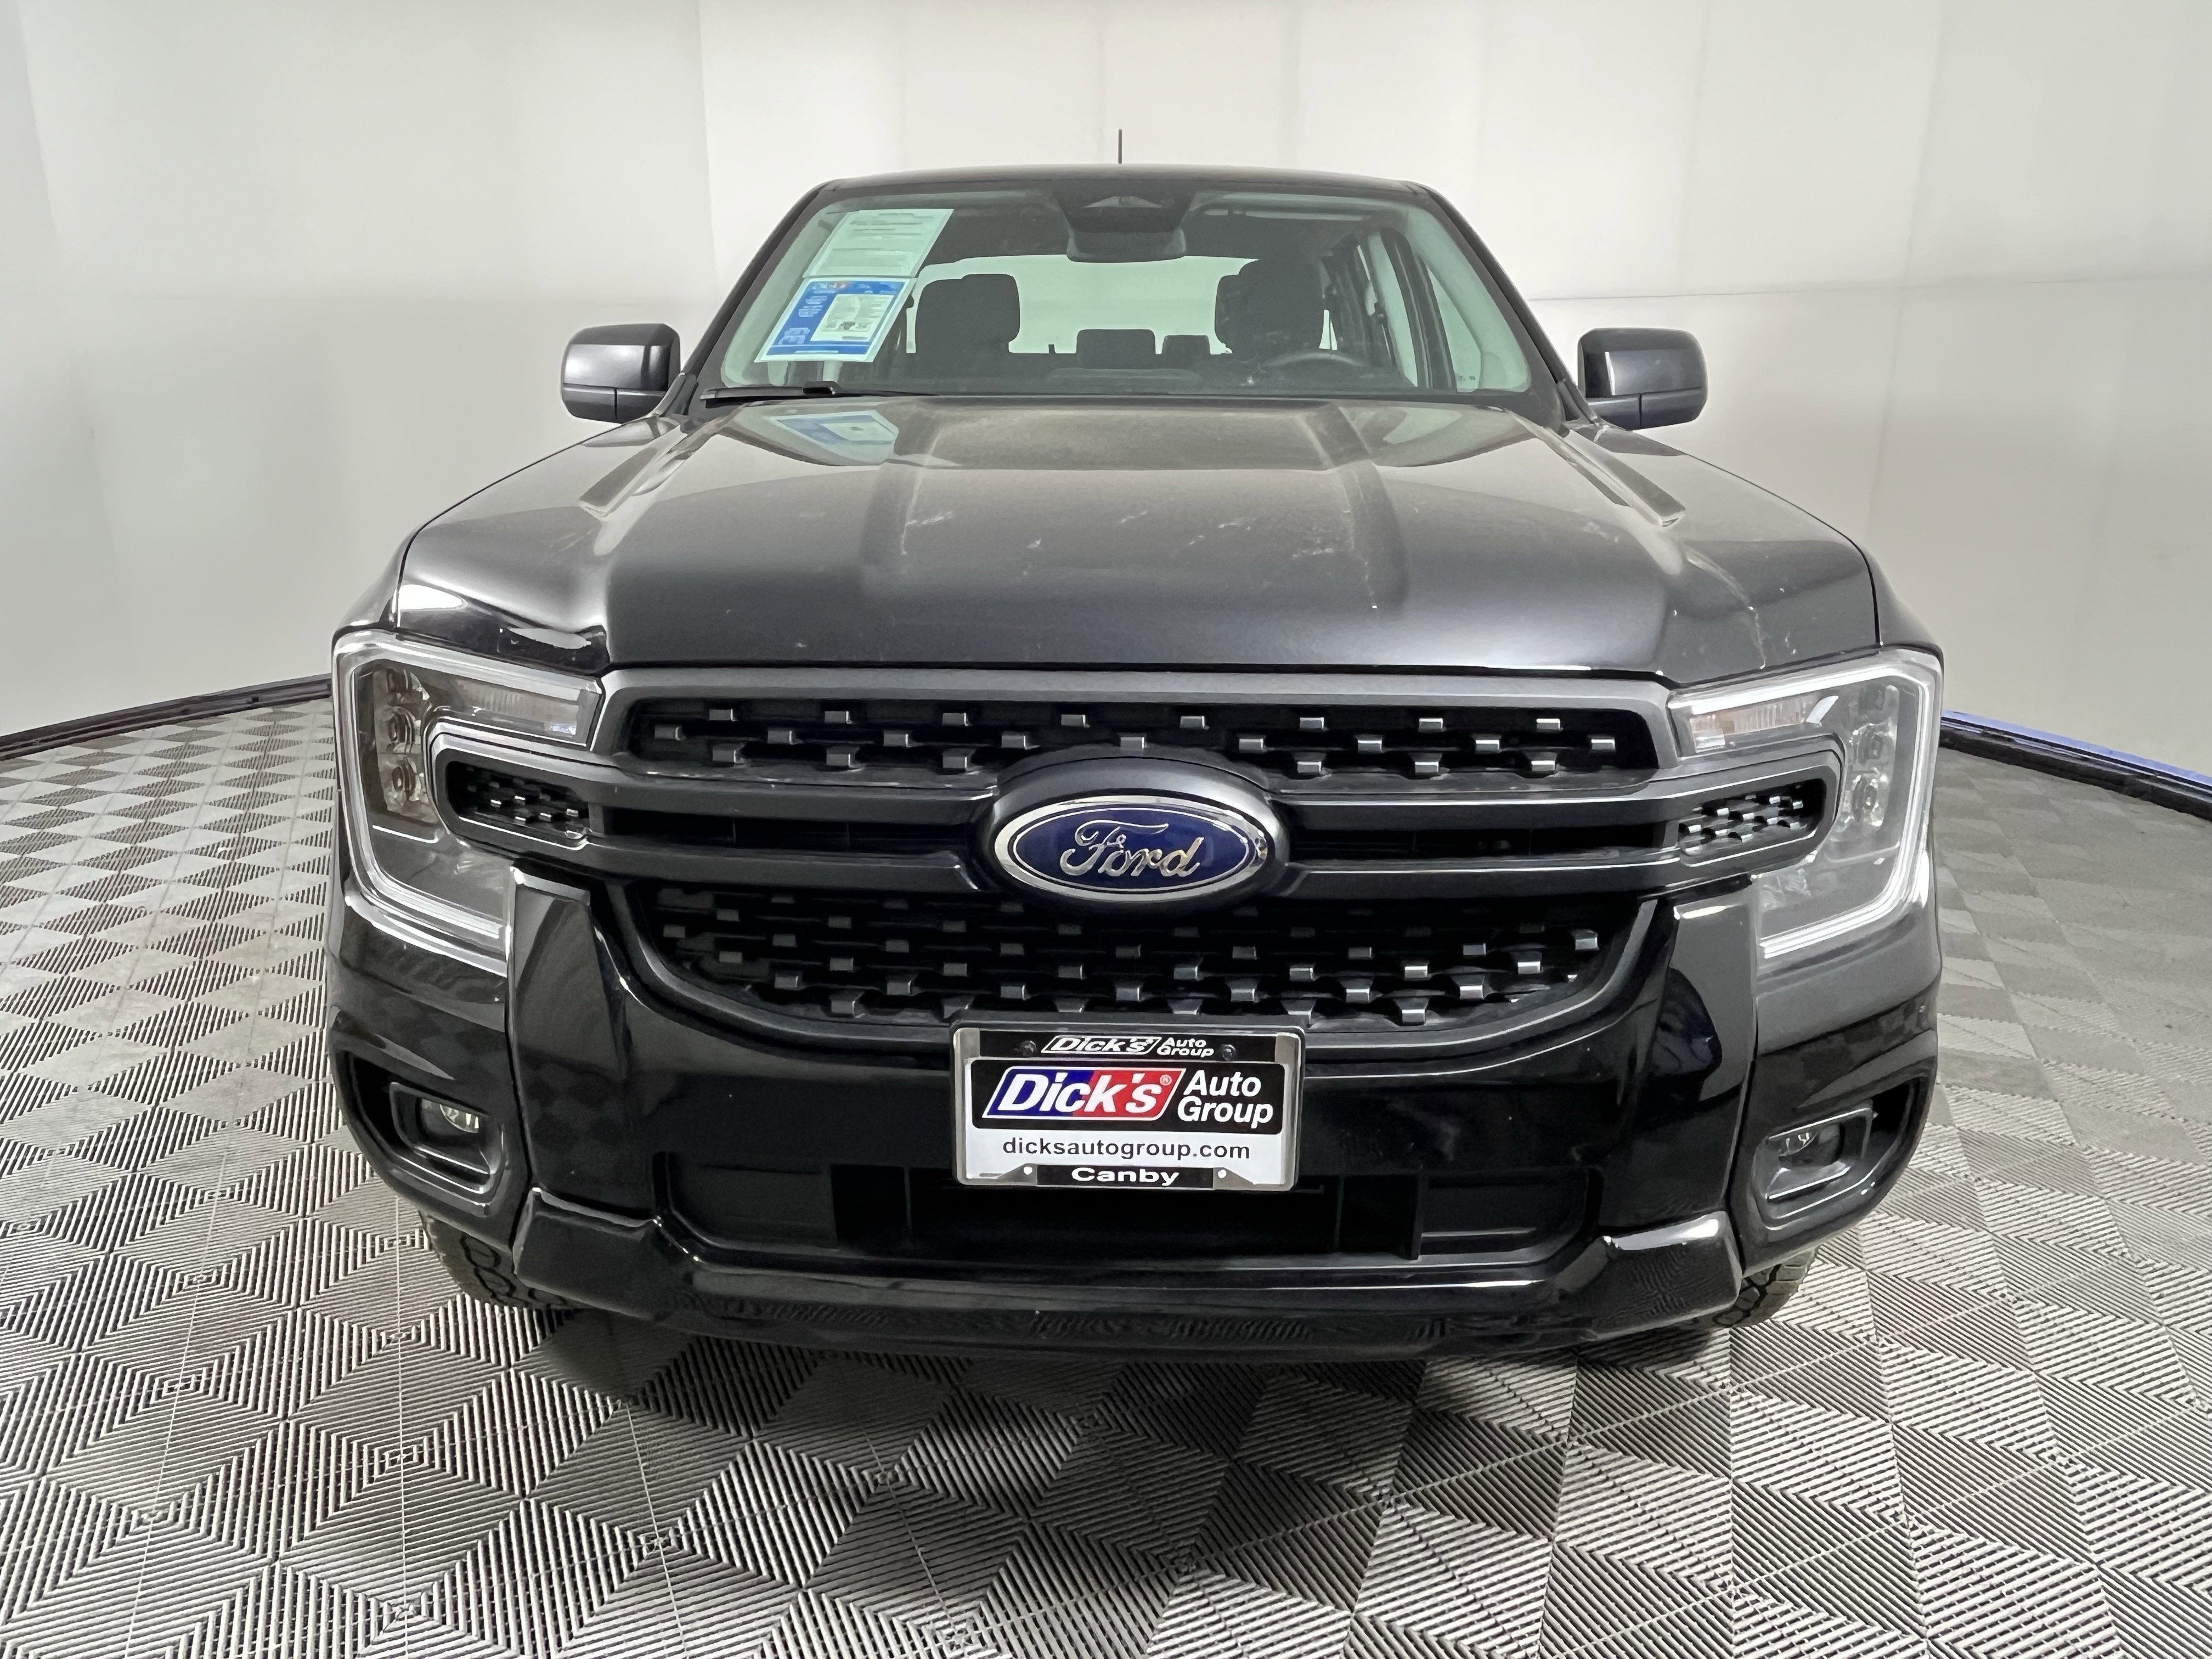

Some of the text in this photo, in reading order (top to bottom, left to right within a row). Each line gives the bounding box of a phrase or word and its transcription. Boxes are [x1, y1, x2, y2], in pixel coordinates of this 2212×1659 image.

[1060, 820, 1205, 877] Ford
[1050, 1036, 1207, 1052] Dick's Auto
[1157, 1047, 1214, 1058] Group
[1184, 1070, 1261, 1097] Auto
[1177, 1096, 1273, 1128] Group
[1003, 1137, 1250, 1160] dicksautogroup.com
[1071, 1167, 1180, 1186] Canby
